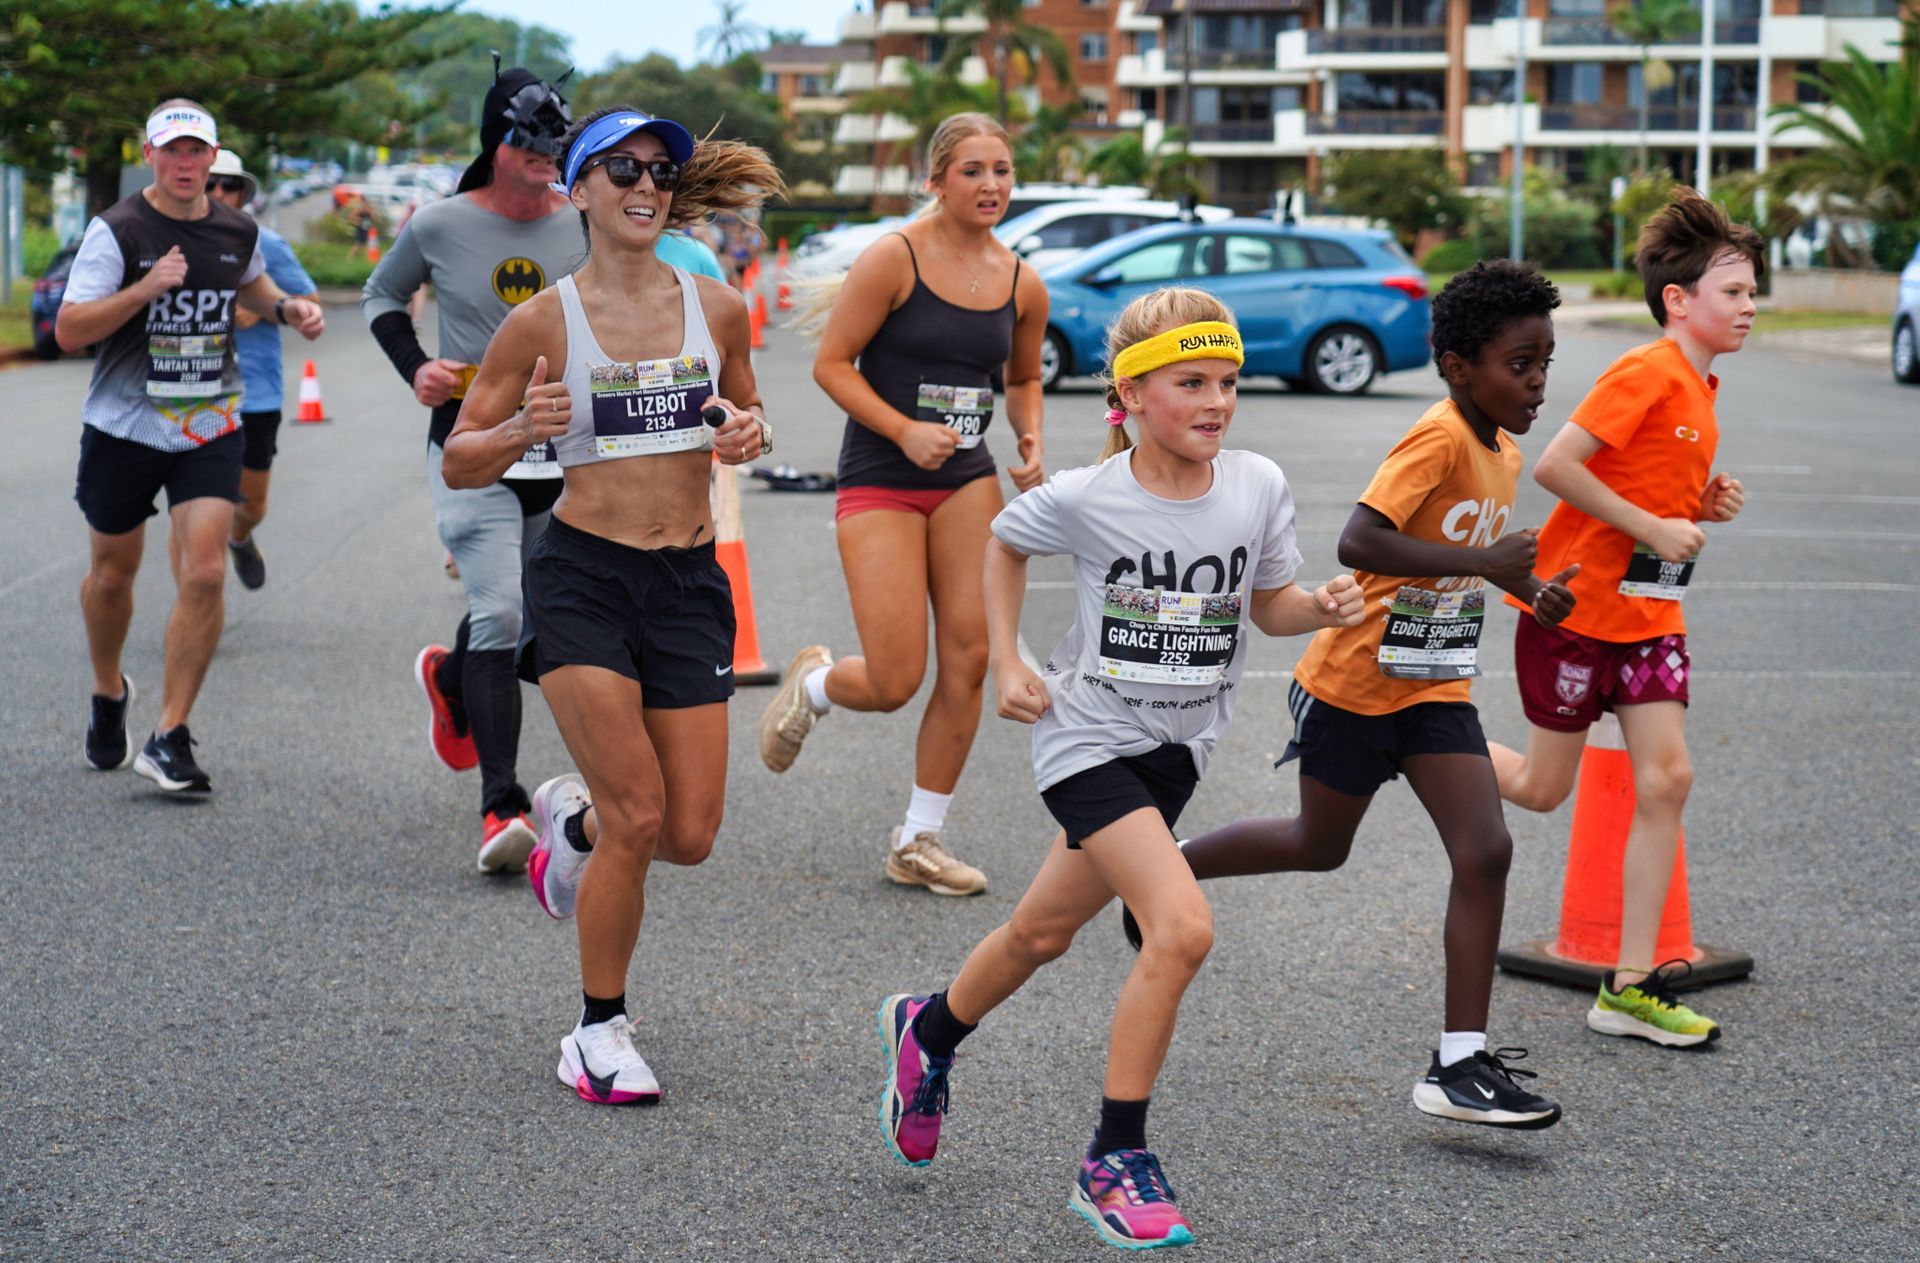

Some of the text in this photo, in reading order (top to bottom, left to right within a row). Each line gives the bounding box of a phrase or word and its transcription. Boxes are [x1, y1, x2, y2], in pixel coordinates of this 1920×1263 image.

[148, 289, 236, 323] RSPT
[146, 321, 191, 333] FITNESS
[1179, 334, 1238, 352] RUN HAPPY
[153, 358, 189, 372] TARTAN
[626, 392, 687, 417] LIZBOT
[645, 415, 676, 431] 2134
[944, 414, 981, 434] 2490
[1442, 498, 1510, 548] CHO
[1659, 561, 1685, 575] TOBY
[1129, 621, 1146, 631] Chop
[1153, 624, 1167, 632] Chill
[1181, 626, 1200, 635] Family
[1391, 621, 1479, 639] EDDIE SPAGHETTI
[1108, 626, 1232, 652] GRACE LIGHTNING
[1424, 639, 1446, 649] 2247
[1159, 651, 1190, 666] 2252
[1151, 700, 1178, 709] SOUTH
